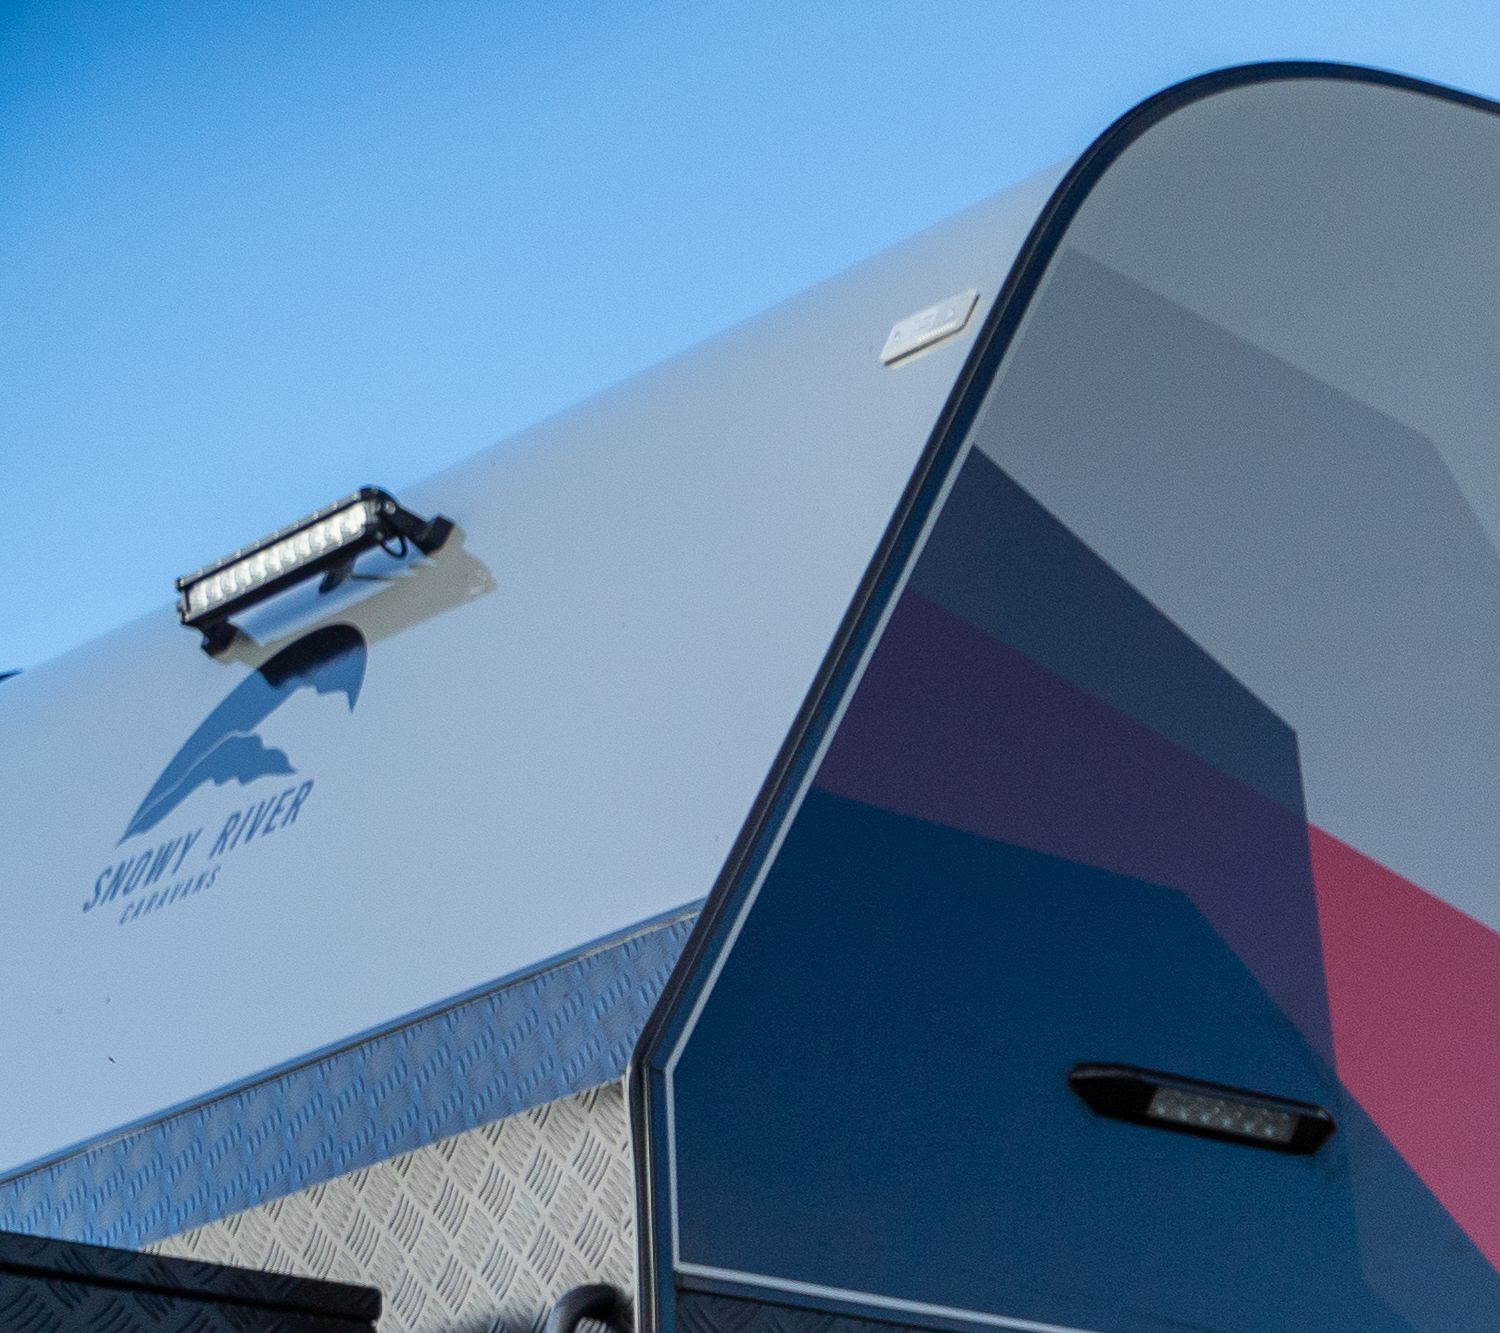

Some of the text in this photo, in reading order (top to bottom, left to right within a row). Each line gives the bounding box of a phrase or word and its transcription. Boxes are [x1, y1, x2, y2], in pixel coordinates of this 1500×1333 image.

[83, 779, 314, 912] SNOWY RIVER
[119, 864, 221, 925] CARAVANS
